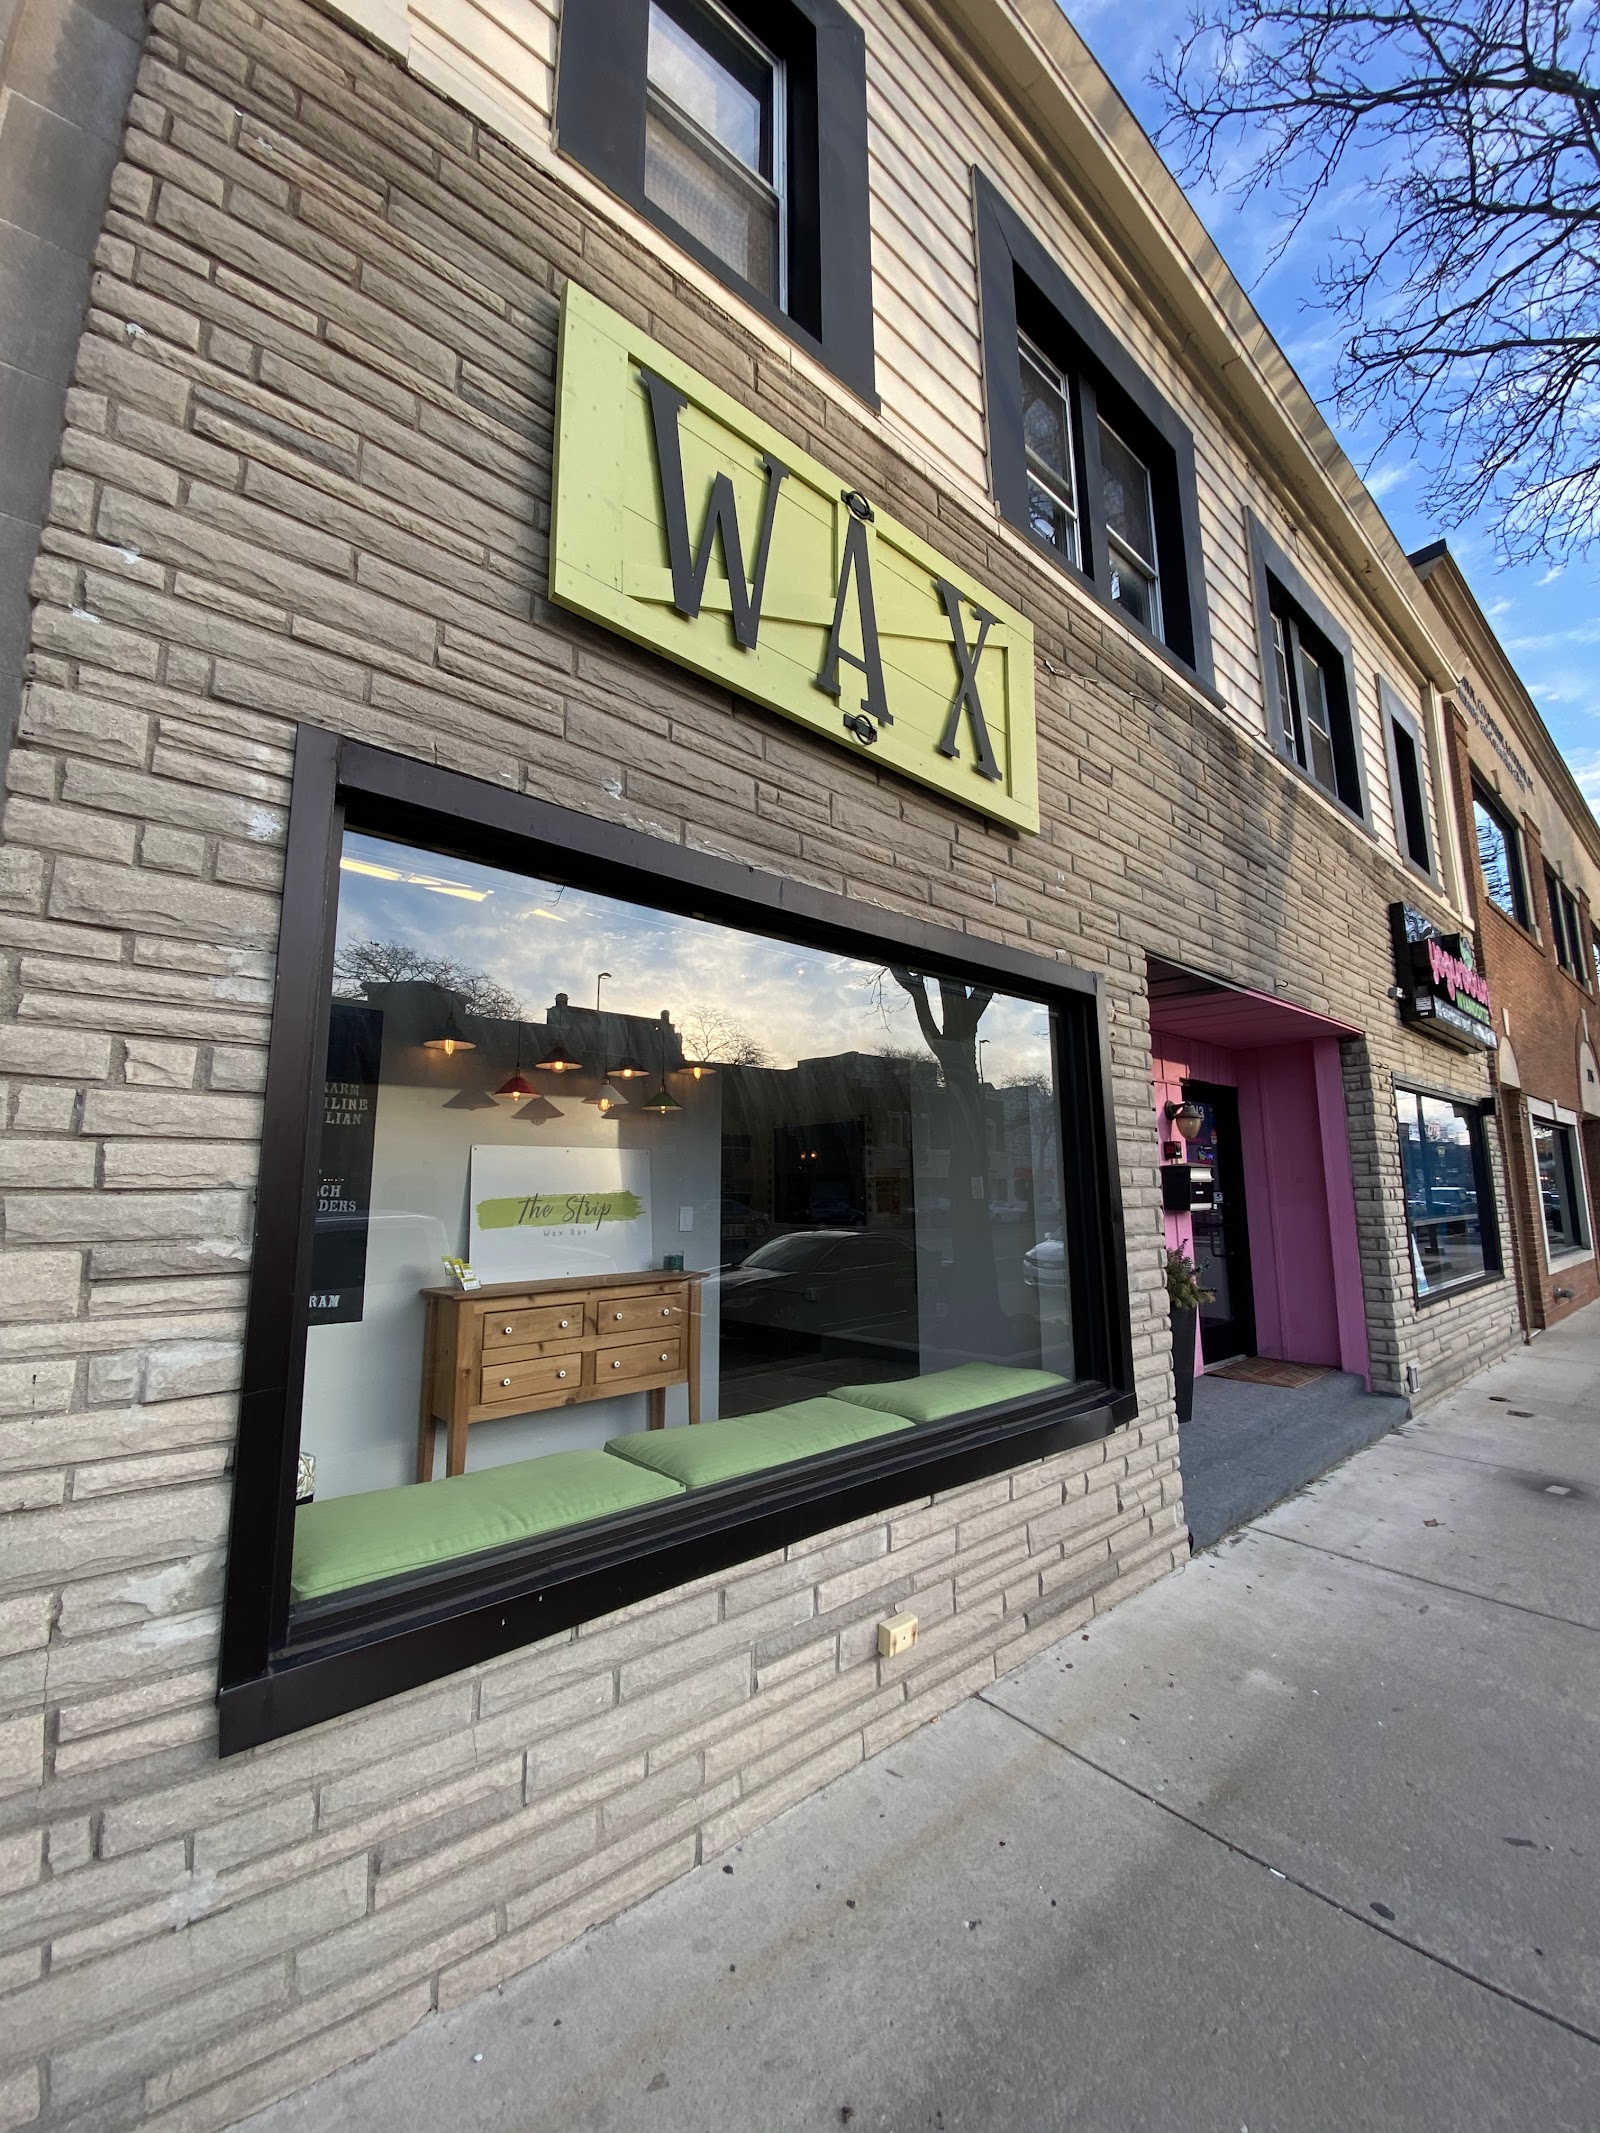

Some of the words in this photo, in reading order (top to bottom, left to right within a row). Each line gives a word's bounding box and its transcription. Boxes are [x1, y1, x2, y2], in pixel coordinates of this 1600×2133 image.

[639, 367, 1002, 781] WAX
[518, 1193, 554, 1224] The
[562, 1194, 612, 1231] Strip
[570, 1228, 588, 1236] Bar
